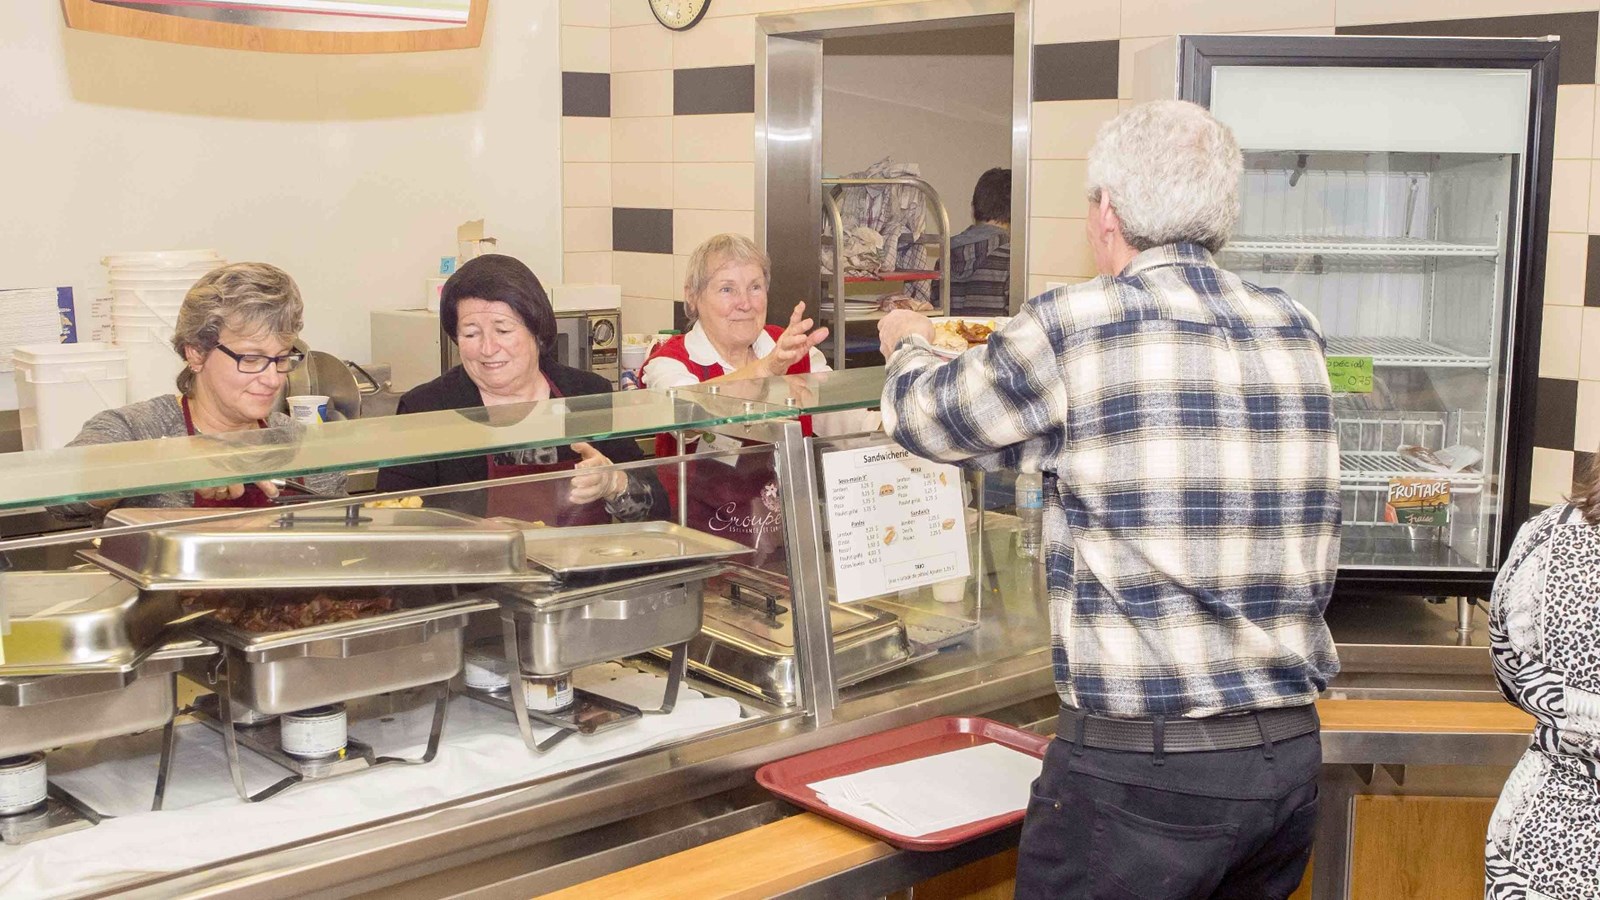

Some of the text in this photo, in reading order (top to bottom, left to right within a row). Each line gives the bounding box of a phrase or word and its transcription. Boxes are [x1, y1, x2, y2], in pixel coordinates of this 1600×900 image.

[665, 4, 670, 15] 7
[688, 3, 693, 14] 5
[676, 10, 681, 20] 6
[863, 450, 909, 464] Sandwicherie
[1388, 482, 1448, 503] FRUTTARE
[1405, 512, 1434, 524] Fraise
[709, 502, 782, 549] Groupe
